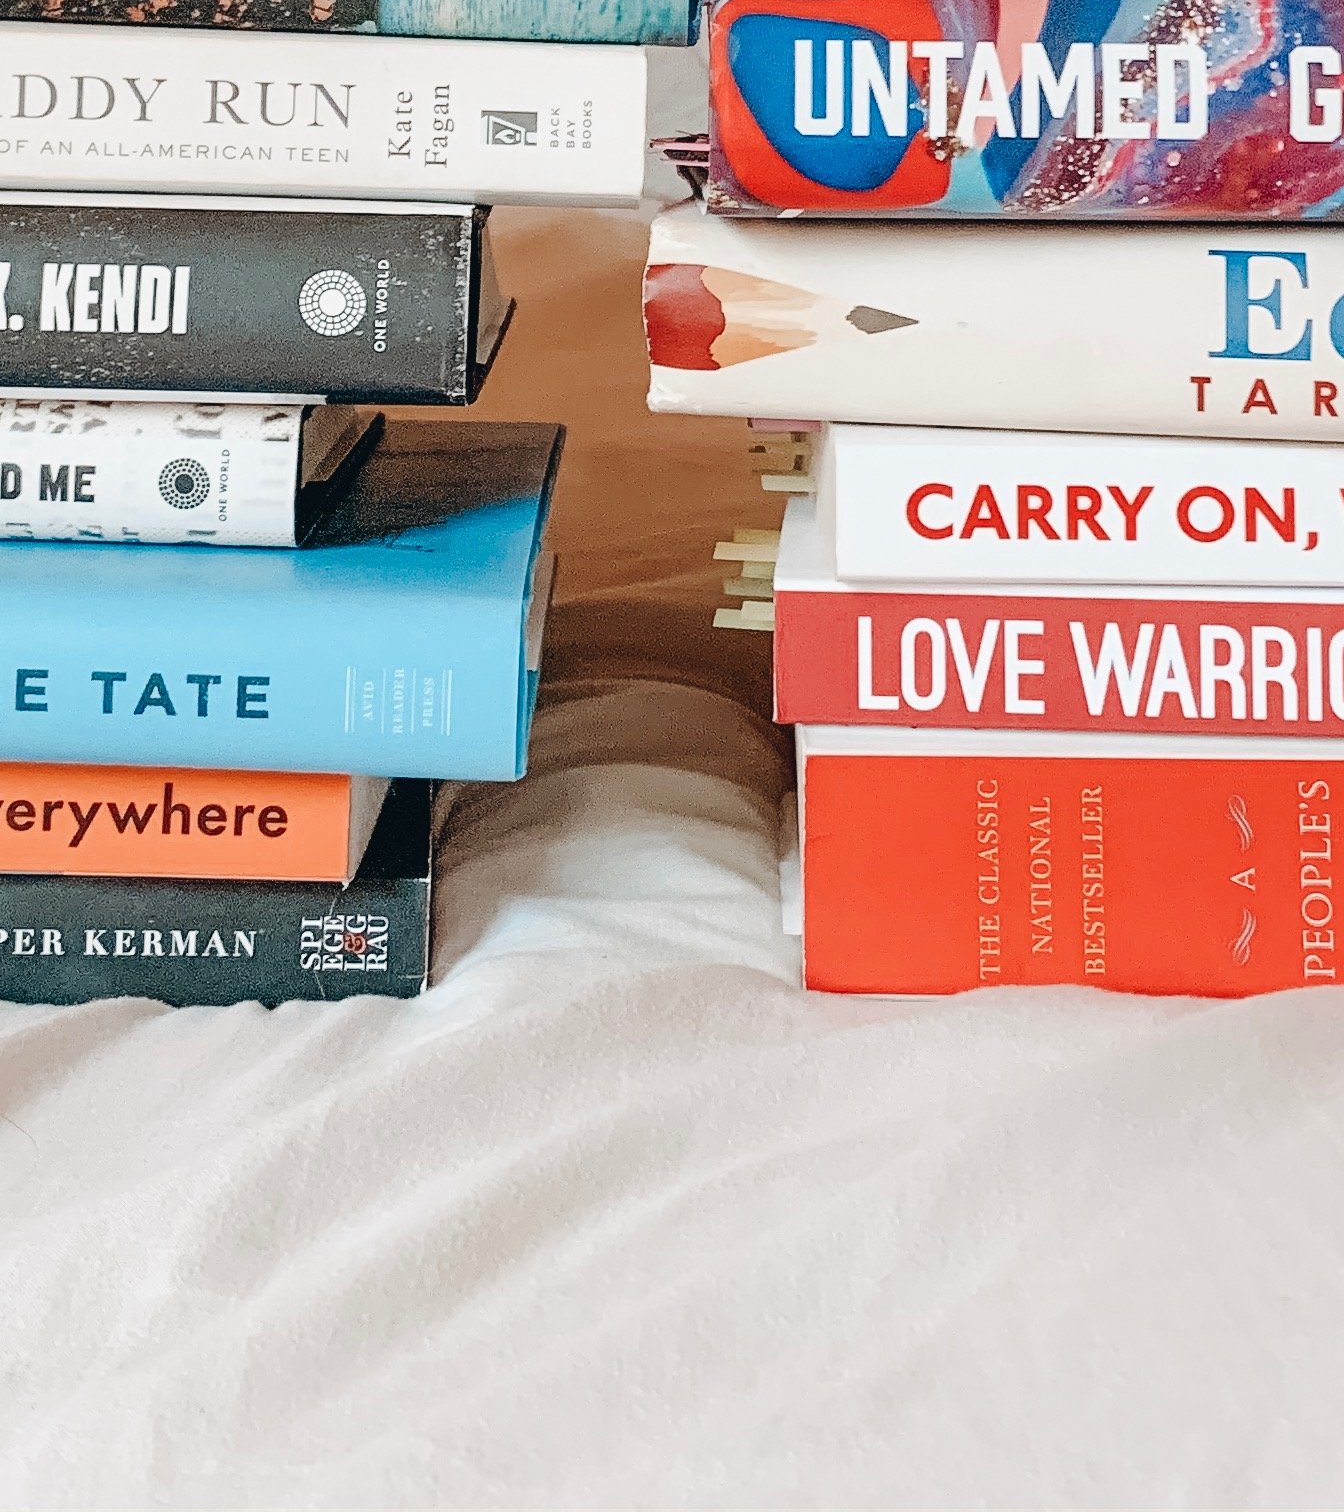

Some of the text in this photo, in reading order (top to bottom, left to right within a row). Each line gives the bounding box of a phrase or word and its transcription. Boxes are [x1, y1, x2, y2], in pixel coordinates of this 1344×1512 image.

[205, 79, 356, 130] RUN
[582, 99, 593, 148] BOOKS
[793, 39, 1209, 143] UNTAMED
[41, 140, 74, 155] AN
[85, 142, 274, 161] ALL-AMERICAN
[285, 147, 350, 163] TEEN
[388, 91, 413, 159] Kate
[424, 84, 455, 168] Fagan
[550, 107, 560, 148] BACK
[566, 120, 576, 148] BAY
[40, 263, 191, 336] KENDI
[374, 259, 390, 353] ONE WORLD
[40, 465, 97, 504] ME
[218, 449, 230, 522] ONE WORLD
[905, 483, 1154, 540] CARRY
[1177, 486, 1319, 552] ON,
[91, 671, 271, 719] TATE
[857, 615, 1046, 714] LOVE
[363, 681, 374, 721] AVID
[393, 667, 404, 733] READER
[422, 677, 434, 727] PRESS
[977, 779, 1001, 980] THE CLASSIC
[1028, 796, 1054, 955] NATIONAL
[1080, 785, 1106, 976] BESTSELLER
[1230, 866, 1256, 891] A
[1298, 779, 1335, 980] PEOPLE'S
[85, 930, 257, 960] KERMAN
